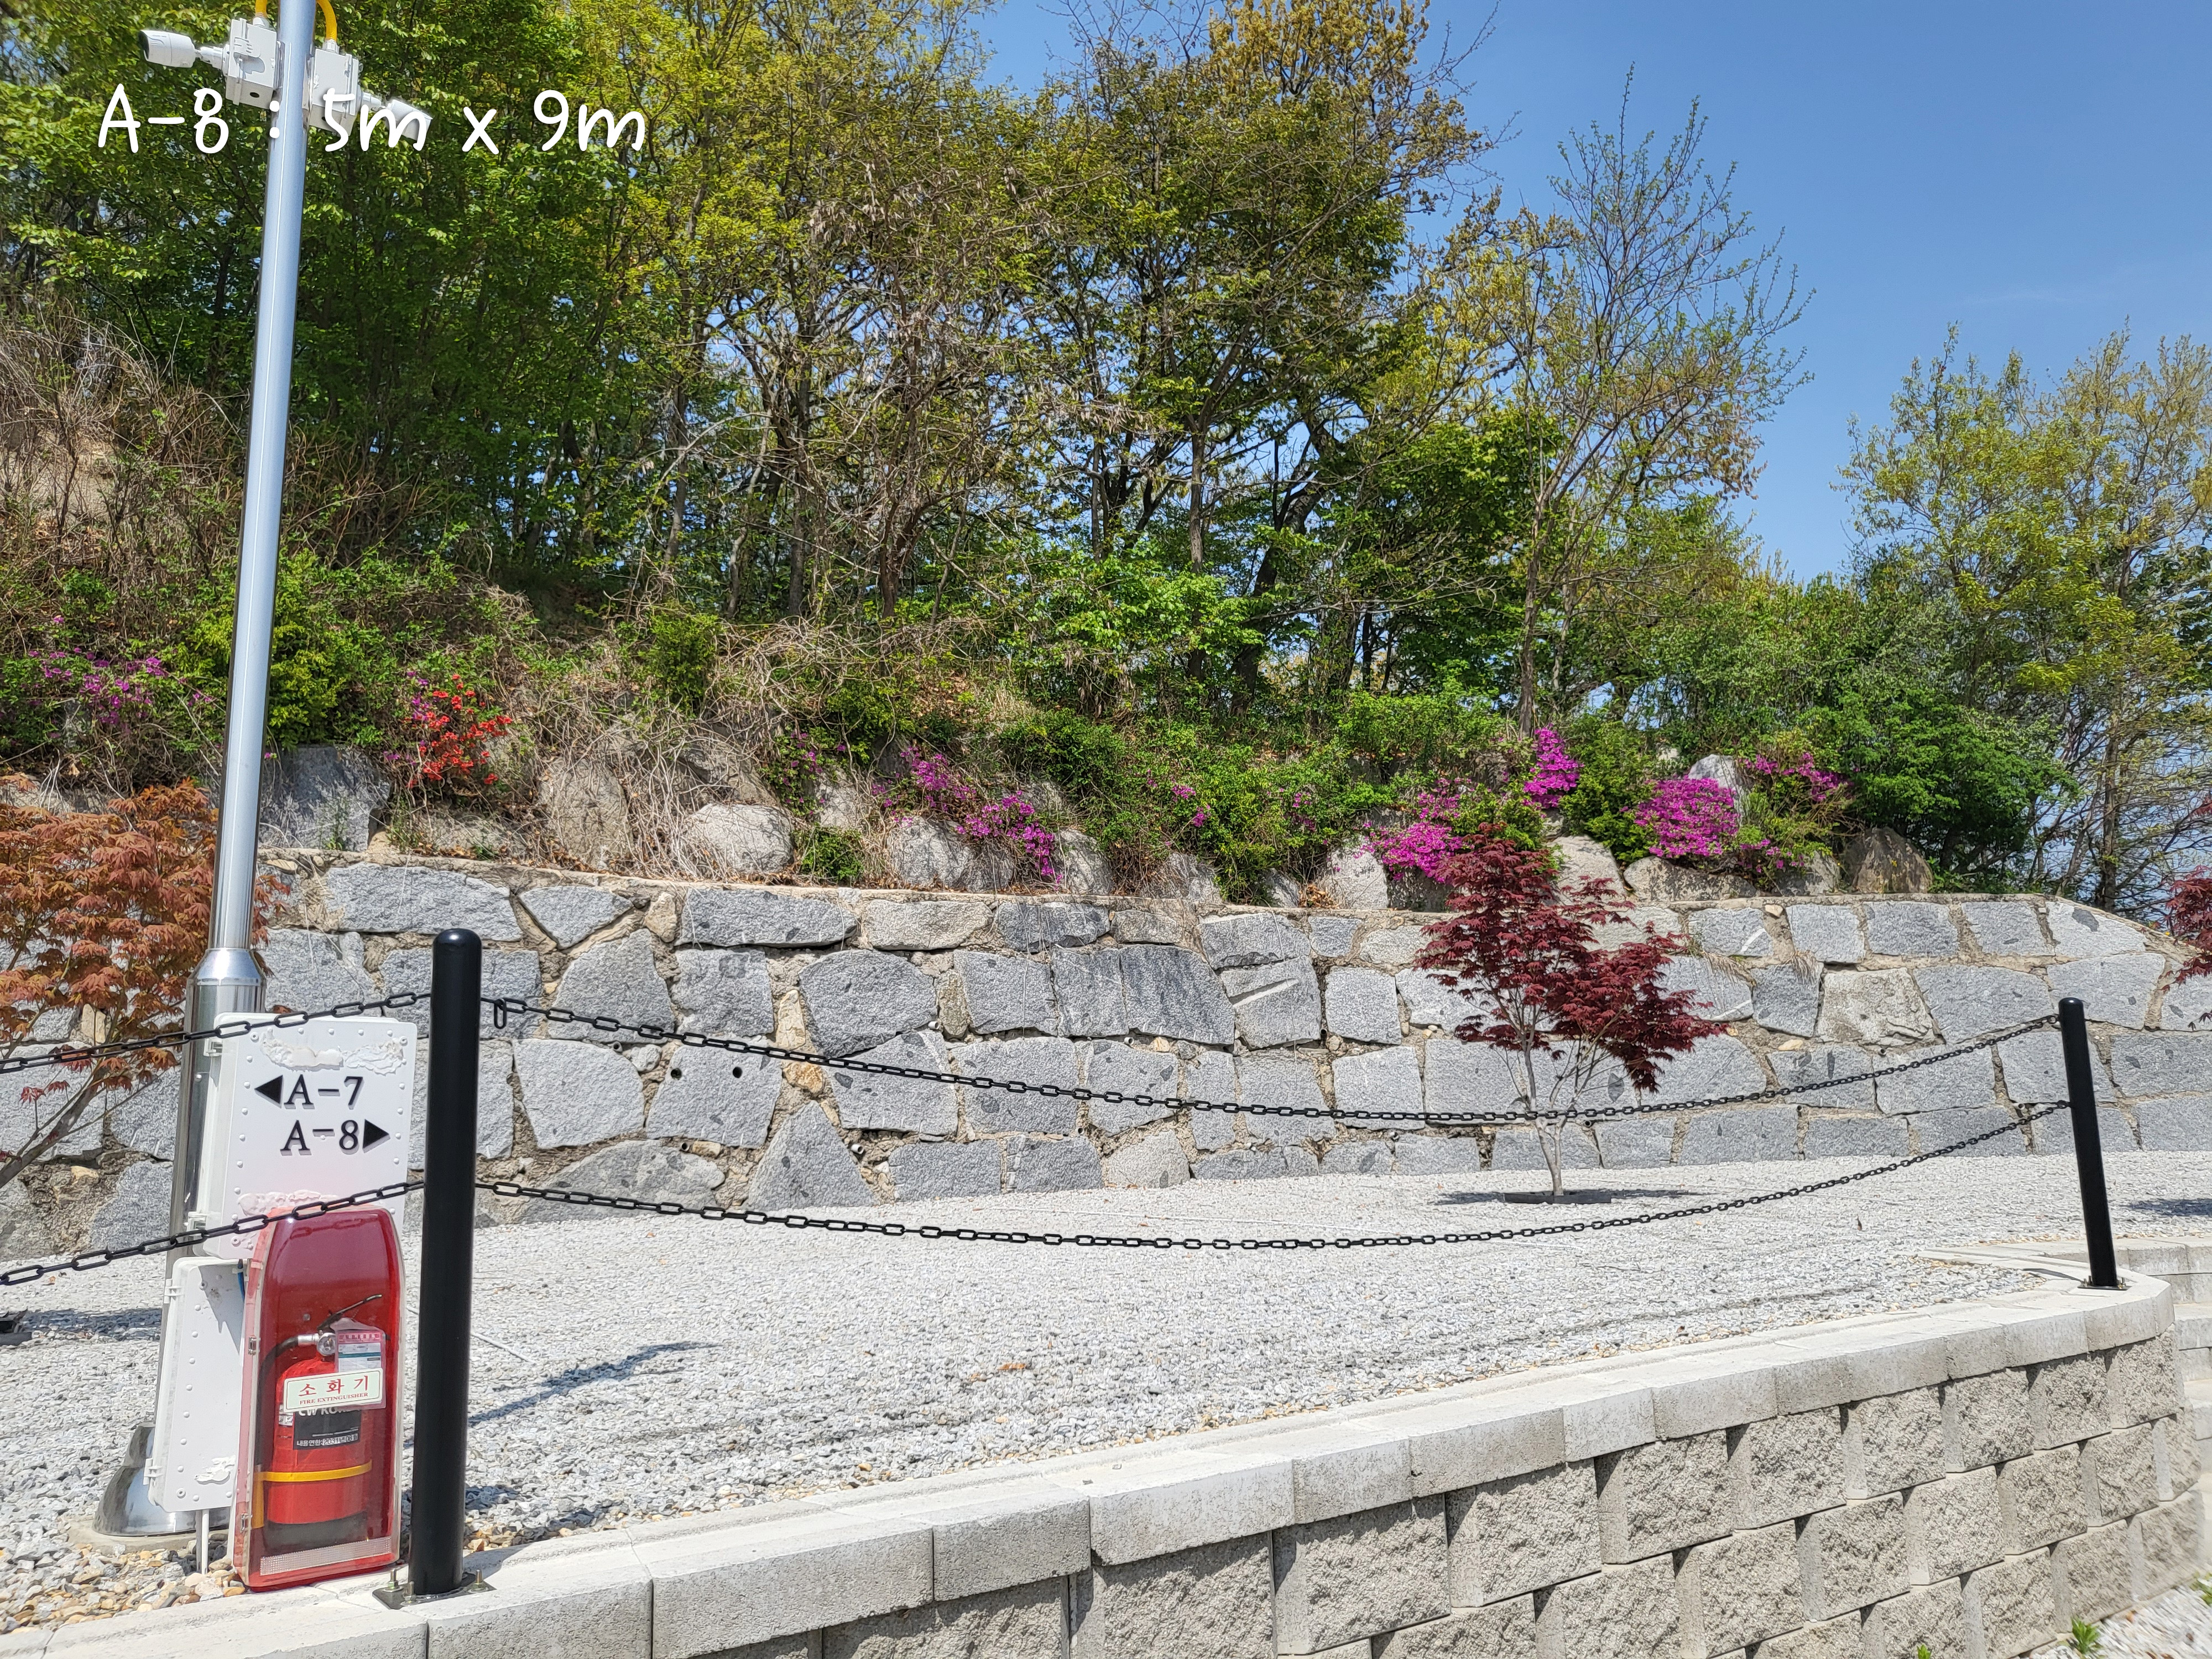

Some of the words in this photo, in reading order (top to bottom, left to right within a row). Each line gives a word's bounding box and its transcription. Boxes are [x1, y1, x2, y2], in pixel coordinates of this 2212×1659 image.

[284, 1074, 364, 1106] A-7
[280, 1119, 359, 1151] A-8
[317, 1392, 368, 1403] EXTINGUISHER
